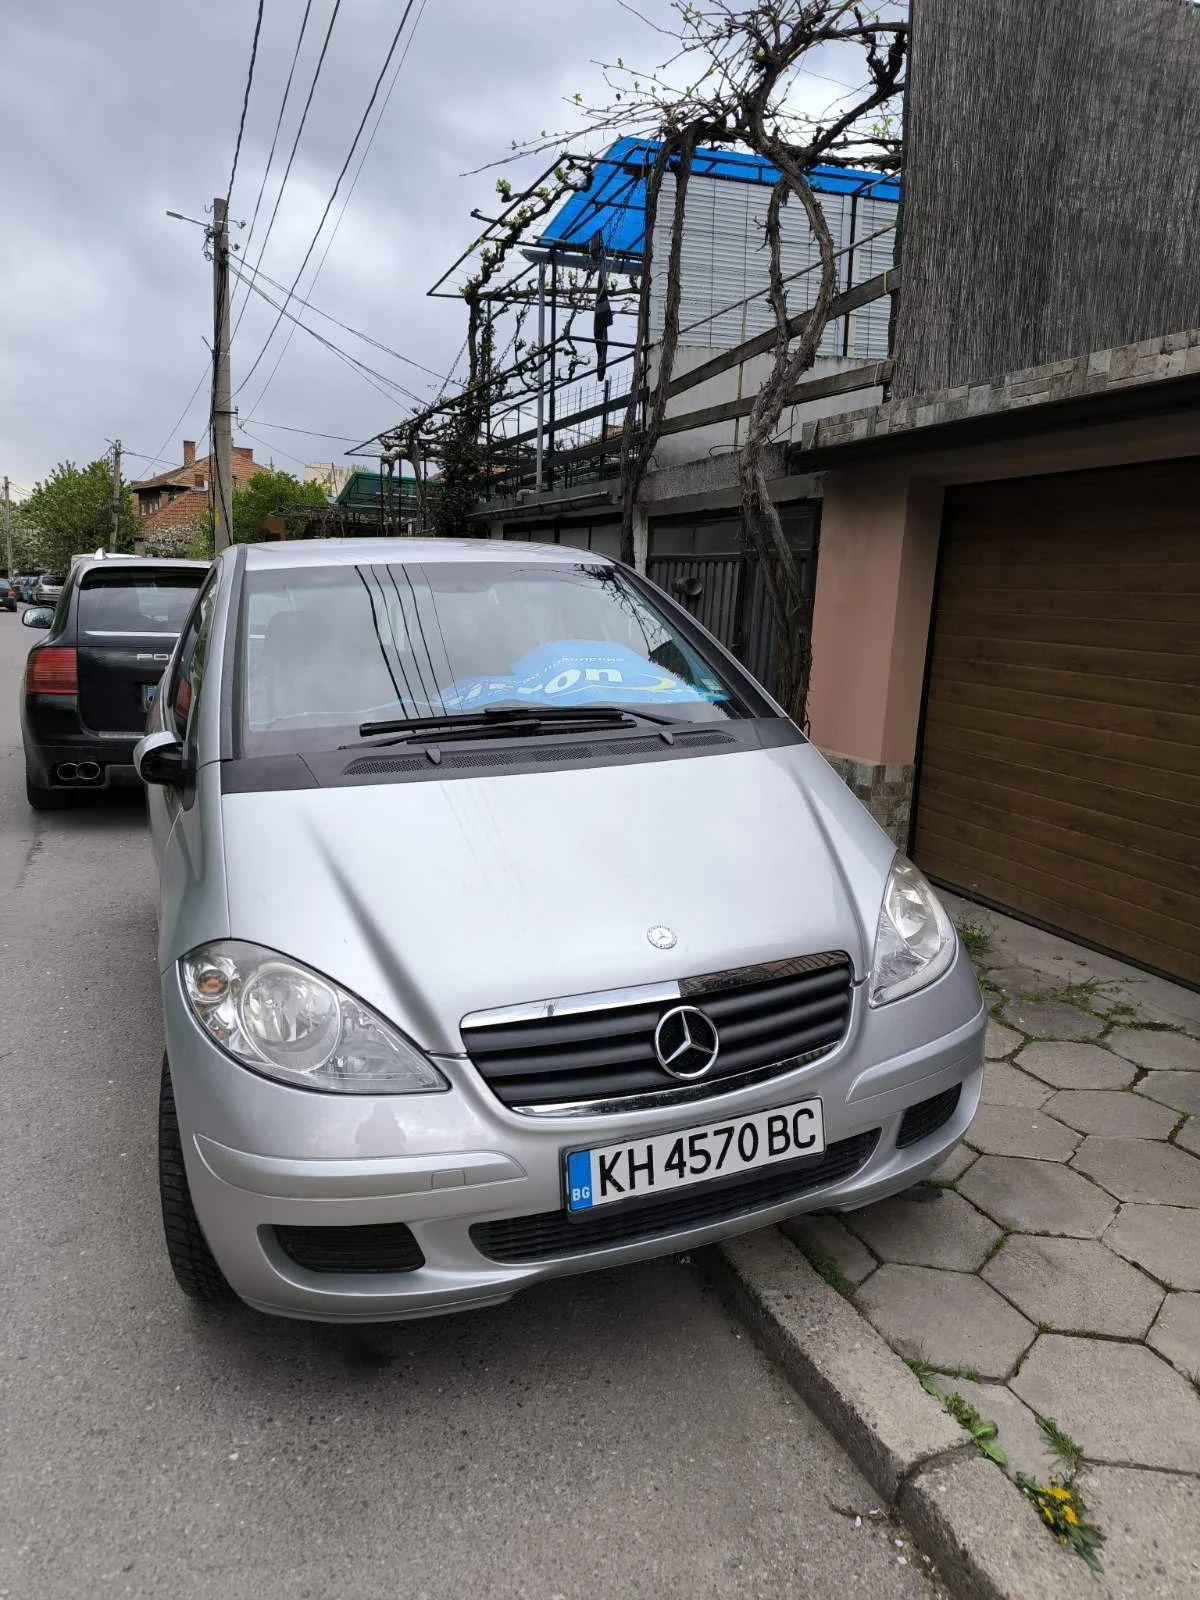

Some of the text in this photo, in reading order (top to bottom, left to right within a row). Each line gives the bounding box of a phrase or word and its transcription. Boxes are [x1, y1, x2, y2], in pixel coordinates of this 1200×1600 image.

[136, 653, 174, 661] PO
[599, 1108, 817, 1197] KH 4570 BC
[572, 1186, 591, 1201] BG
